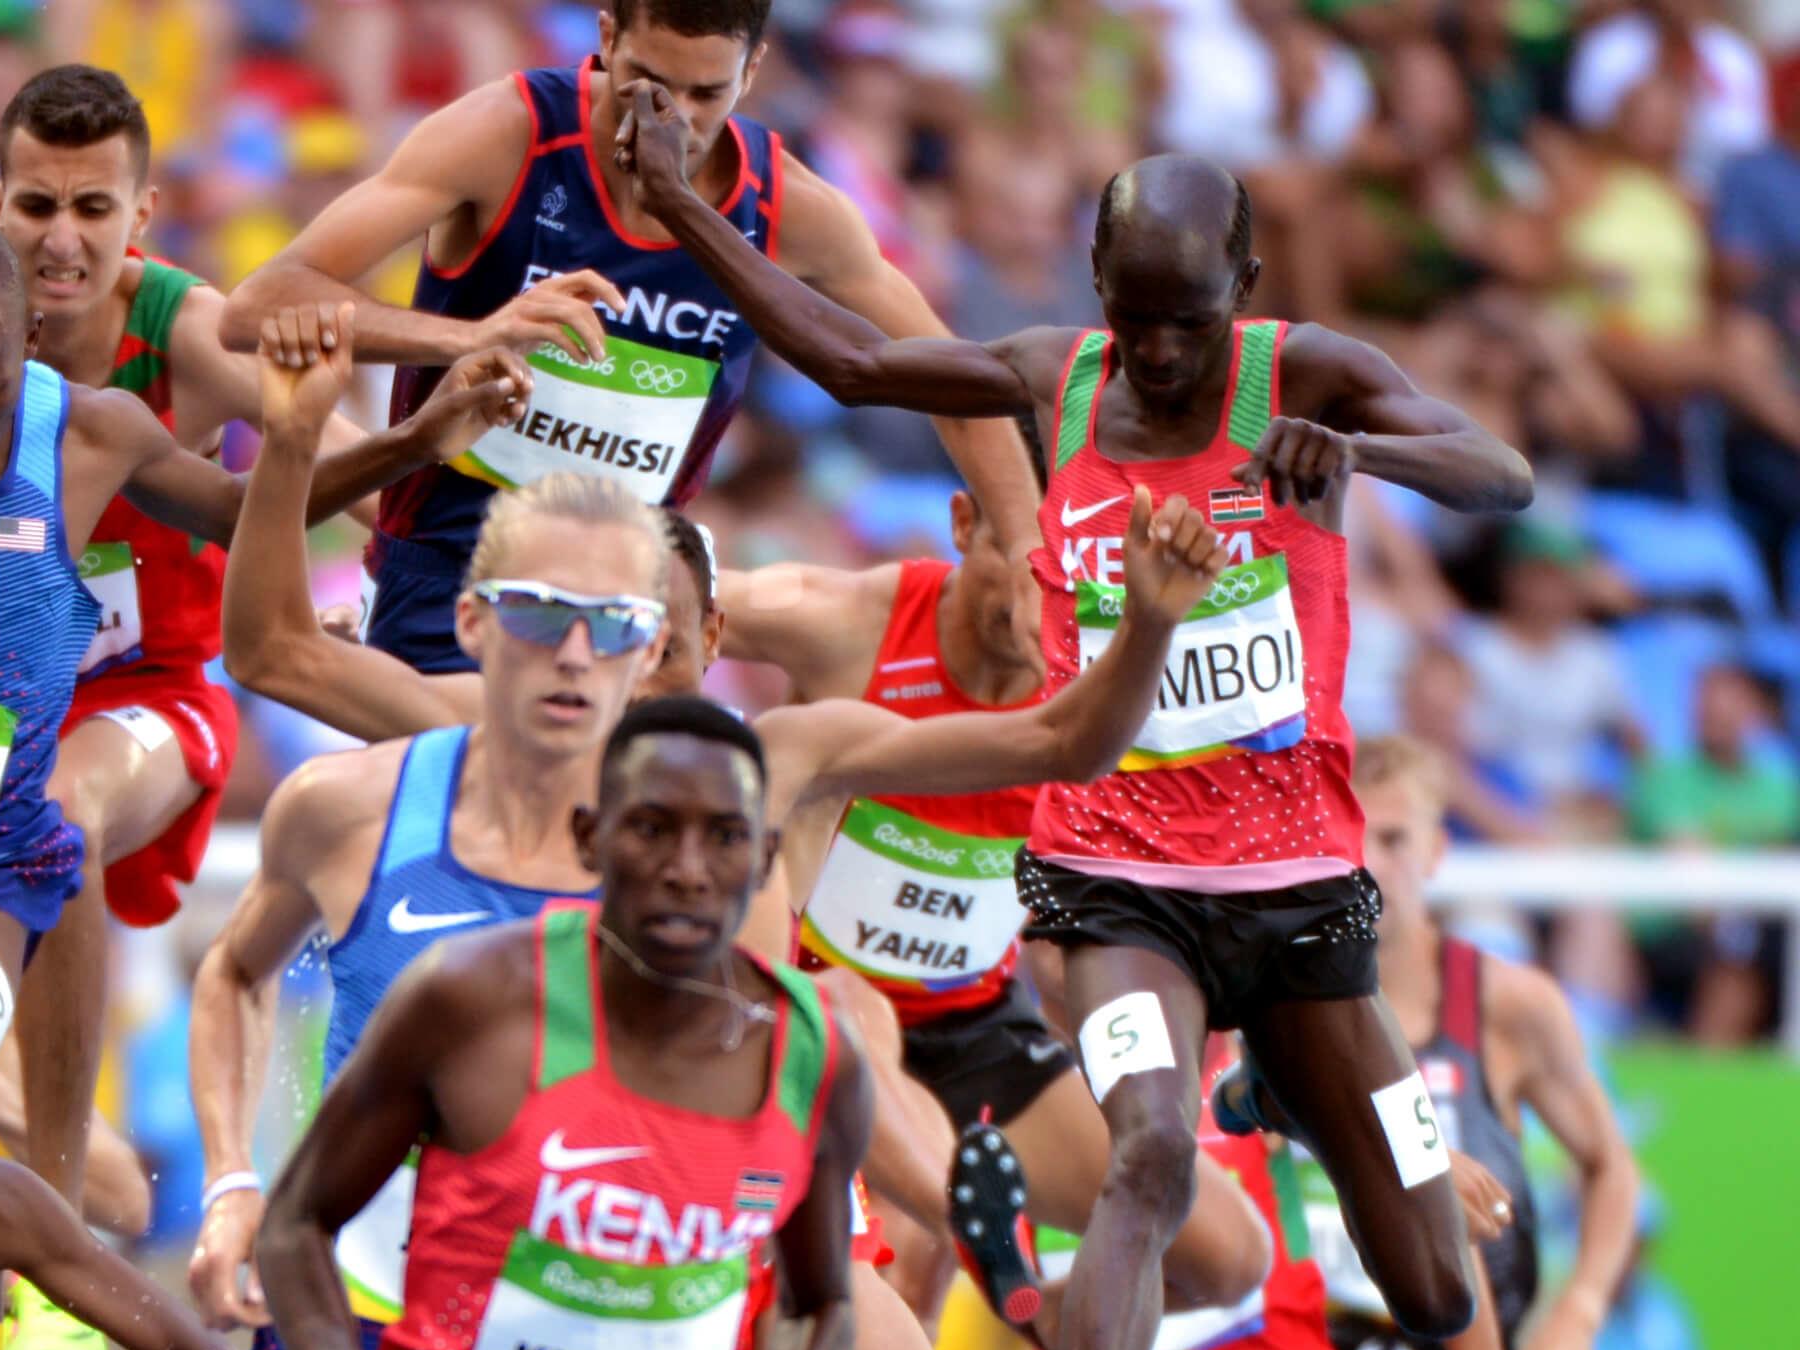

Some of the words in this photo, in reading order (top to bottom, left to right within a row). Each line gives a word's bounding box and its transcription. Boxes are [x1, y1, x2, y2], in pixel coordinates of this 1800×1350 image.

[872, 823, 967, 867] Rio2016
[893, 880, 976, 921] BEN
[853, 919, 970, 970] YAHIA
